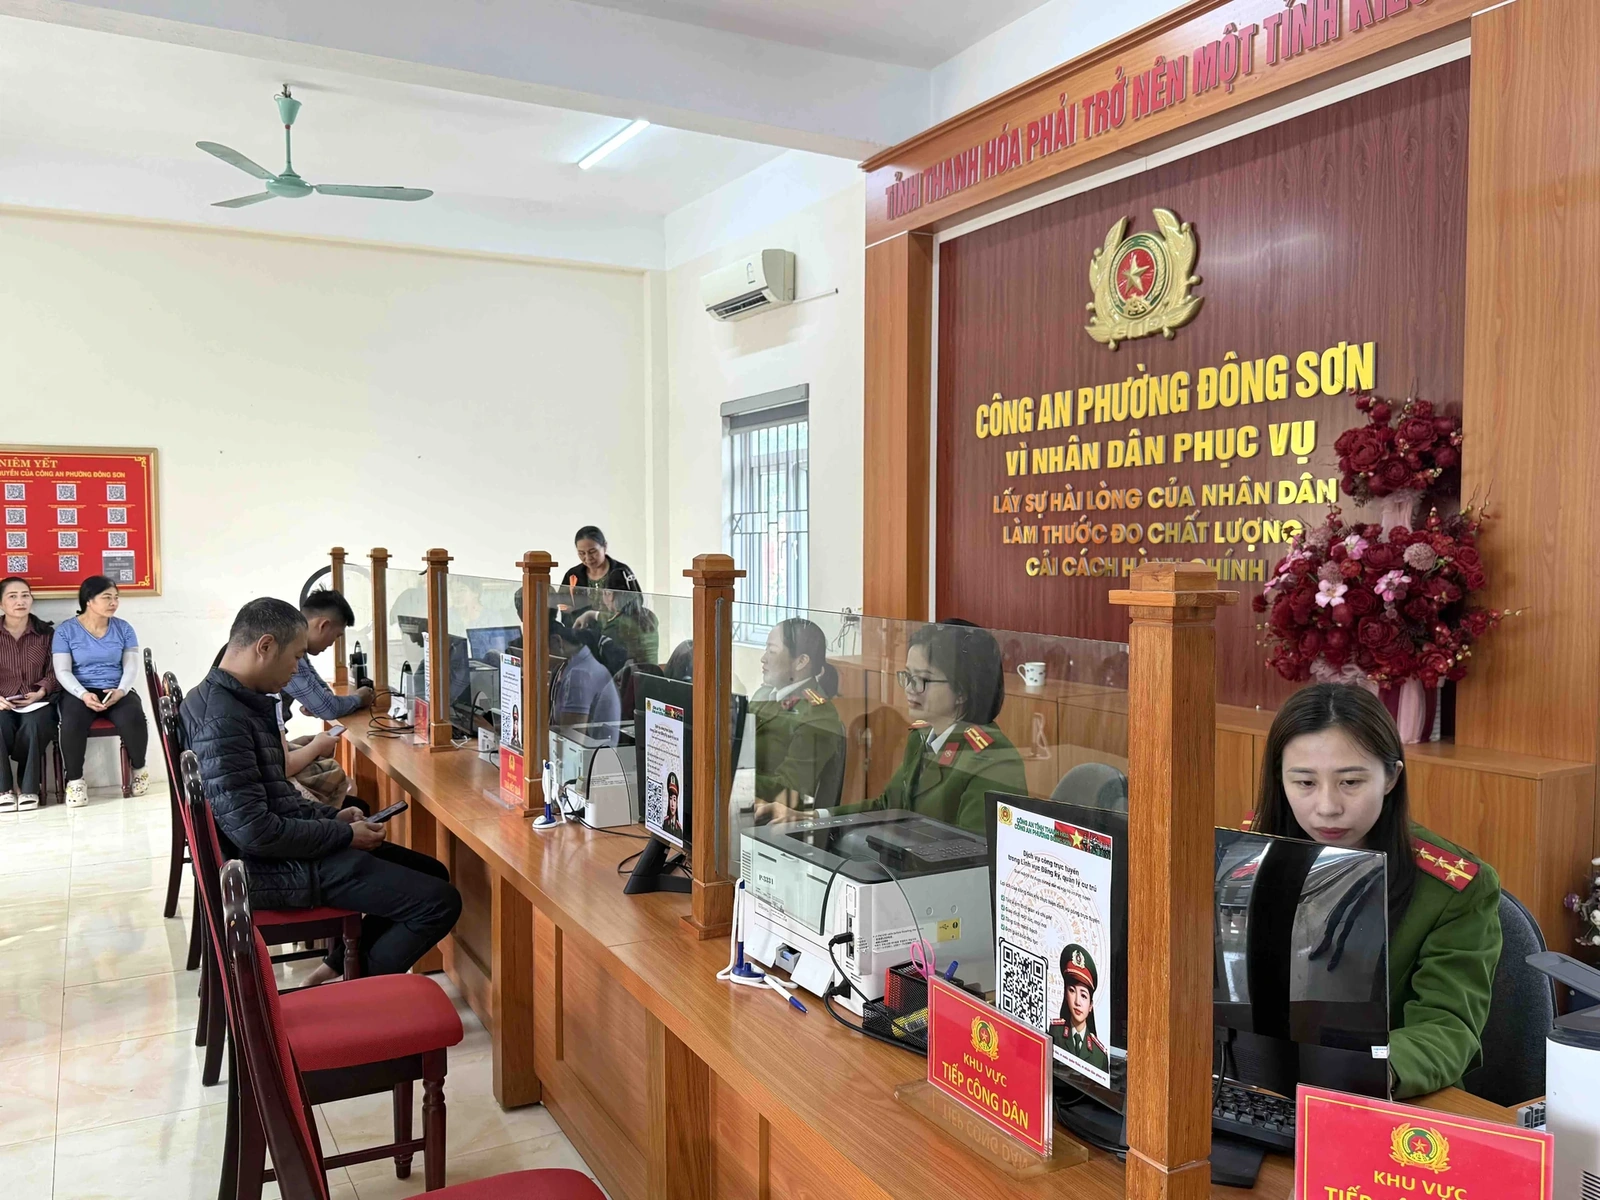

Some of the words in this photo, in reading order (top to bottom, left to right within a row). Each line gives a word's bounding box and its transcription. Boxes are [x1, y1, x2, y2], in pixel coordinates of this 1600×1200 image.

[885, 172, 923, 220] TỈNH
[924, 145, 982, 204] THANH
[984, 124, 1023, 179] HÓA
[1026, 92, 1078, 163] PHẢI
[1082, 65, 1129, 139] TRỞ
[1132, 55, 1188, 120] NÊN
[1193, 22, 1258, 93] MỘT
[1263, 0, 1341, 65] TỈNH
[976, 393, 1034, 439] CÔNG
[1037, 388, 1073, 430] AN
[1077, 363, 1190, 426] PHƯỜNG
[1197, 350, 1289, 410] ĐÔNG
[1295, 341, 1376, 398] SƠN
[34, 457, 58, 468] YẾT
[1005, 441, 1028, 476] VÌ
[1032, 434, 1099, 475] NHÂN
[1107, 428, 1165, 468] DÂN
[1173, 425, 1260, 468] PHỤC
[1268, 420, 1317, 464] VỤ
[20, 469, 34, 477] CỦA
[993, 487, 1022, 514] LẤY
[1025, 490, 1048, 519] SỰ
[1050, 483, 1082, 512] HÀI
[1086, 481, 1142, 510] LÒNG
[1147, 477, 1195, 508] CỦA
[1201, 476, 1273, 506] NHÂN
[1278, 472, 1338, 505] DÂN
[1003, 517, 1037, 544] LÀM
[1041, 515, 1108, 544] THƯỚC
[1110, 523, 1143, 544] ĐO
[1147, 510, 1210, 544] CHẤT
[1213, 519, 1305, 552] LƯỢNG
[1025, 549, 1058, 576] CẢI
[1062, 548, 1118, 577] CÁCH
[1191, 548, 1268, 581] HÍNH
[963, 1053, 983, 1073] KHU
[985, 1065, 1008, 1088] VỰC
[942, 1061, 964, 1088] TIẾP
[966, 1074, 999, 1111] CÔNG
[1002, 1099, 1029, 1130] DÂN
[1373, 1170, 1416, 1191] KHU
[1422, 1180, 1467, 1200] VỰC
